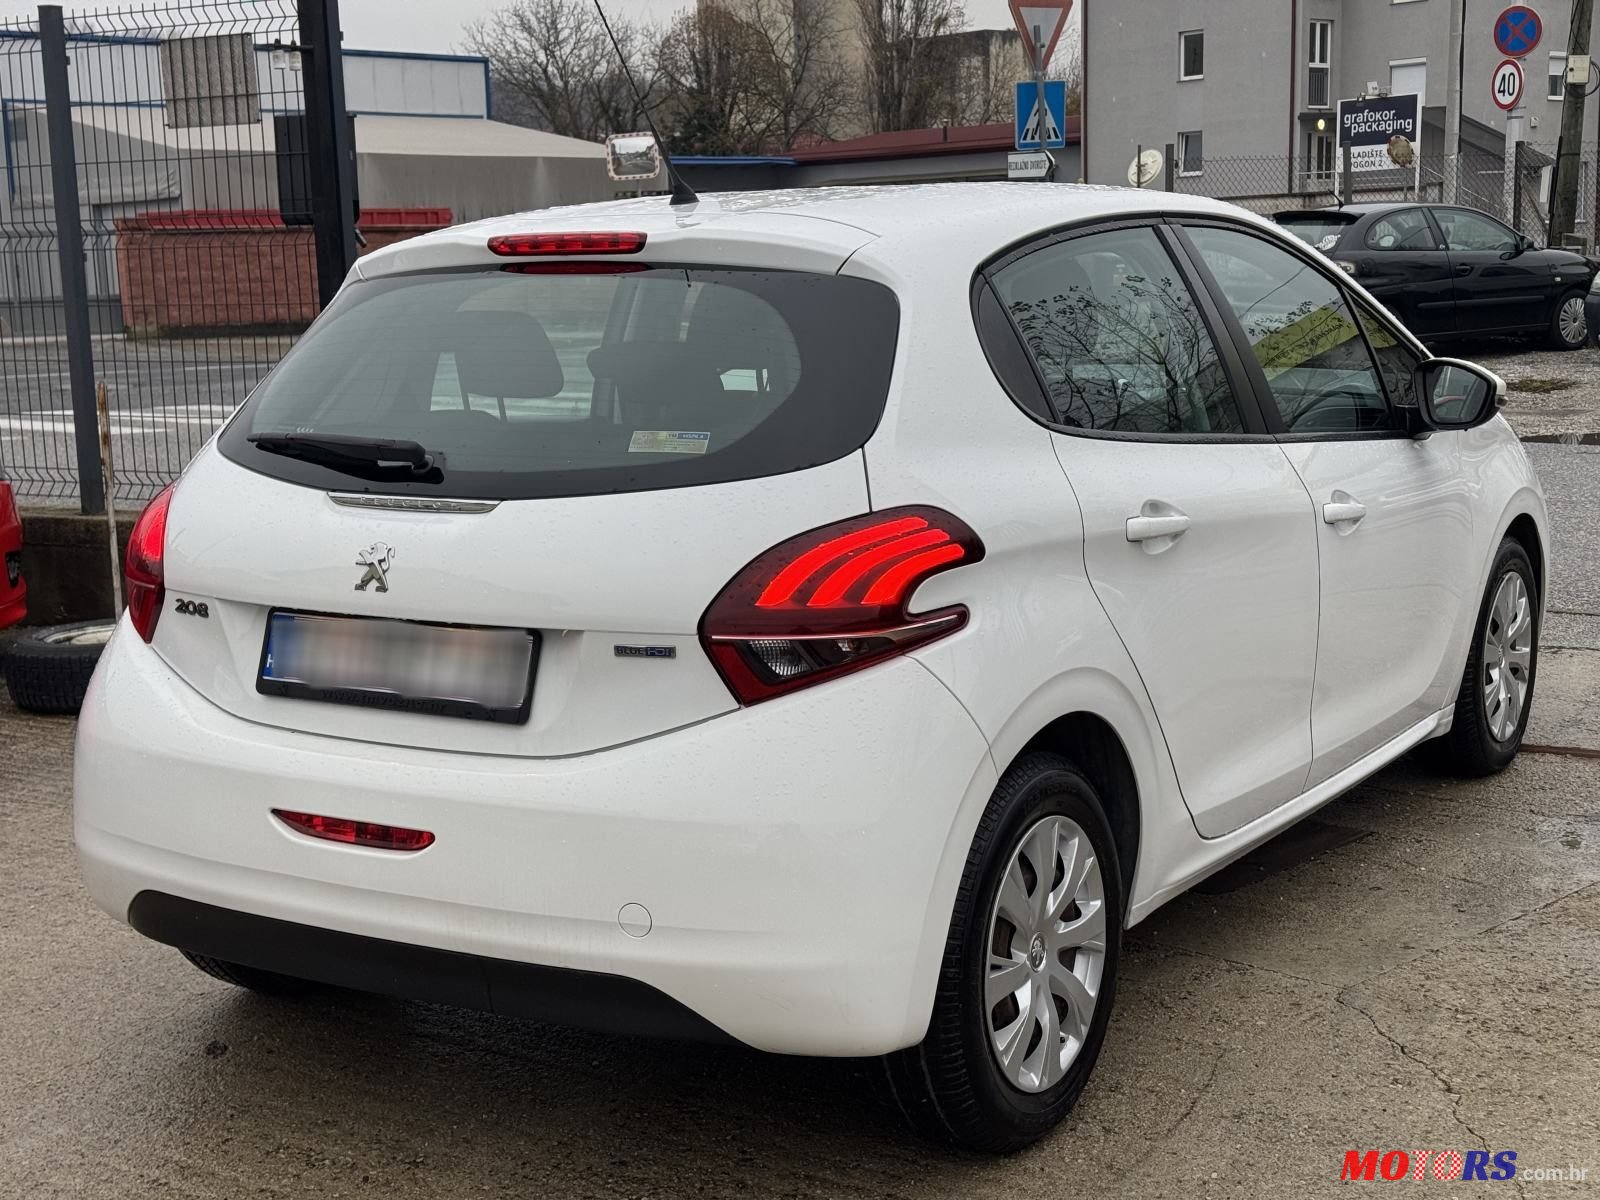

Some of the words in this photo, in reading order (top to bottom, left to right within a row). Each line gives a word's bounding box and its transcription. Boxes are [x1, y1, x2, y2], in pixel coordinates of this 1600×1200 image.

[1498, 72, 1515, 97] 40
[1350, 118, 1413, 136] packaging
[1351, 148, 1384, 159] LADIŠTE
[1351, 160, 1376, 169] OGON
[1378, 159, 1383, 167] 2
[175, 597, 209, 619] 208
